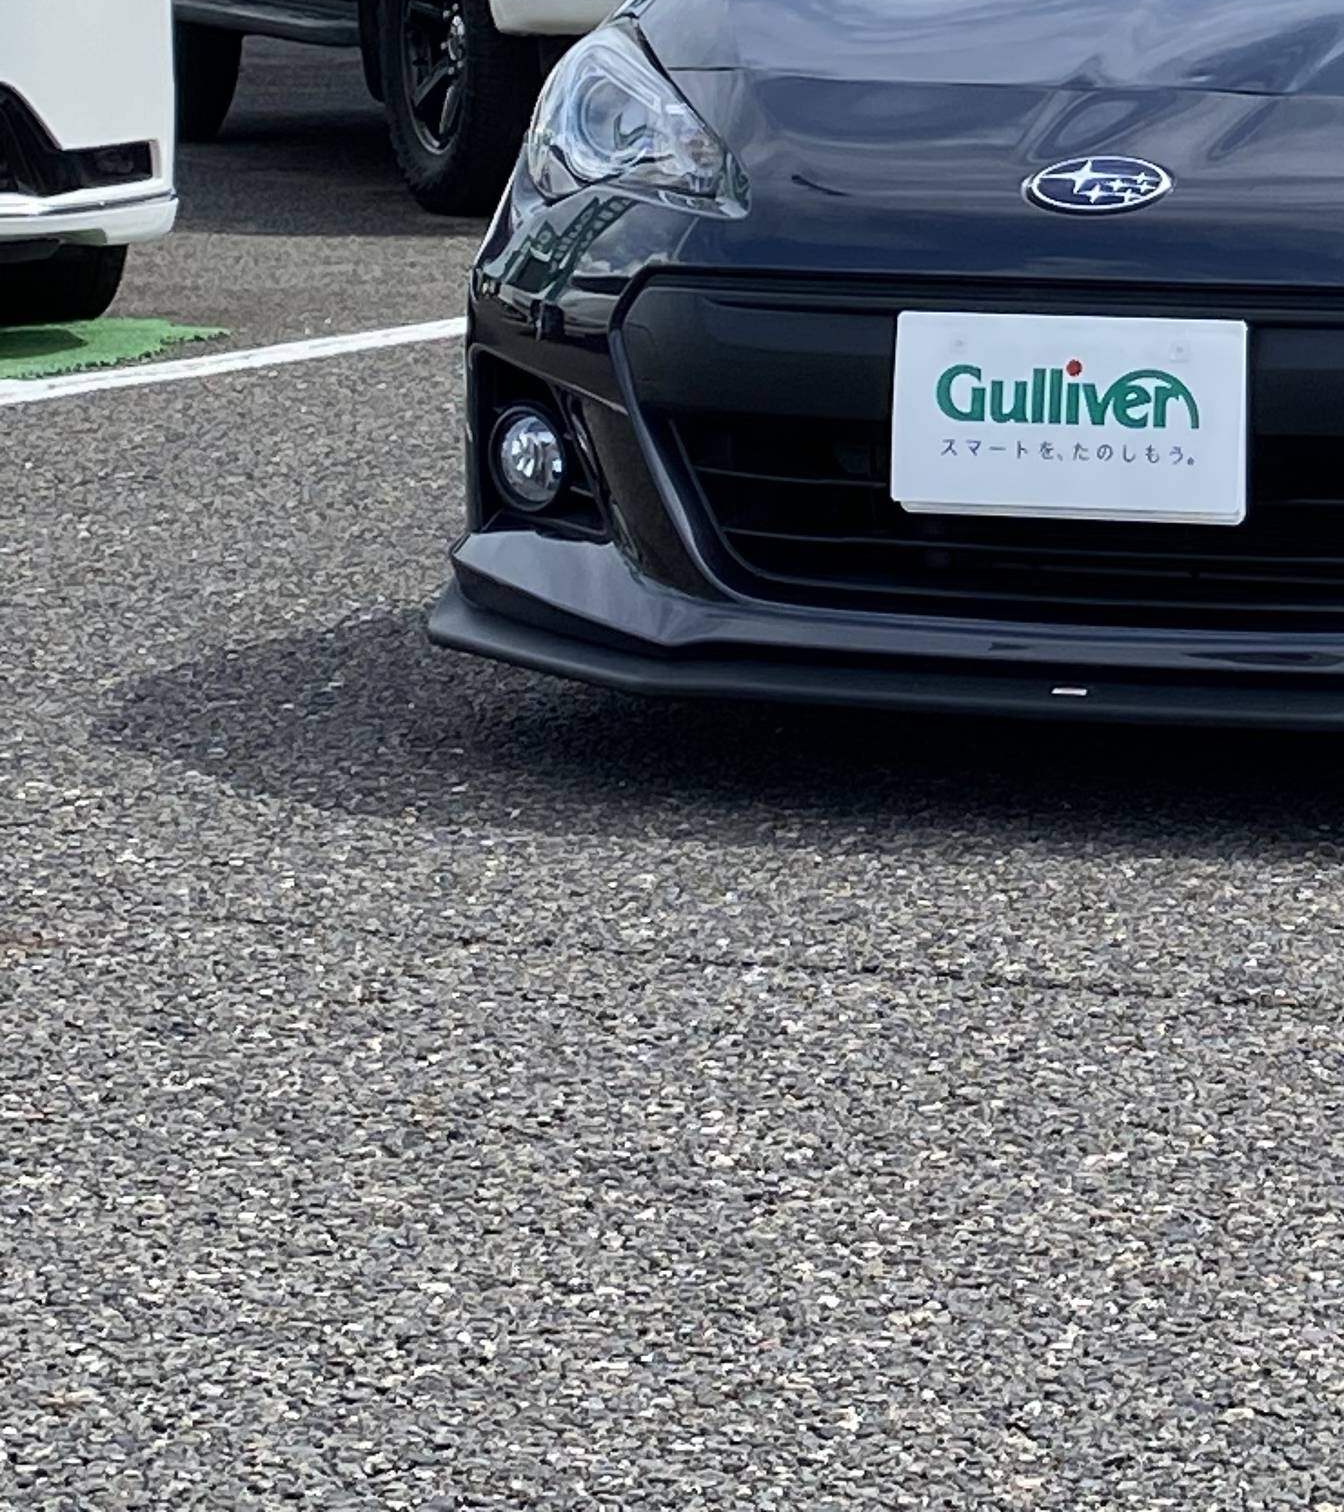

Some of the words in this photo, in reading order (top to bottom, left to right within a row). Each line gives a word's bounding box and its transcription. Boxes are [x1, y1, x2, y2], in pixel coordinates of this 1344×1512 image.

[936, 359, 1200, 430] Gulliver
[941, 438, 1196, 466] スマートを、たのしもう。
